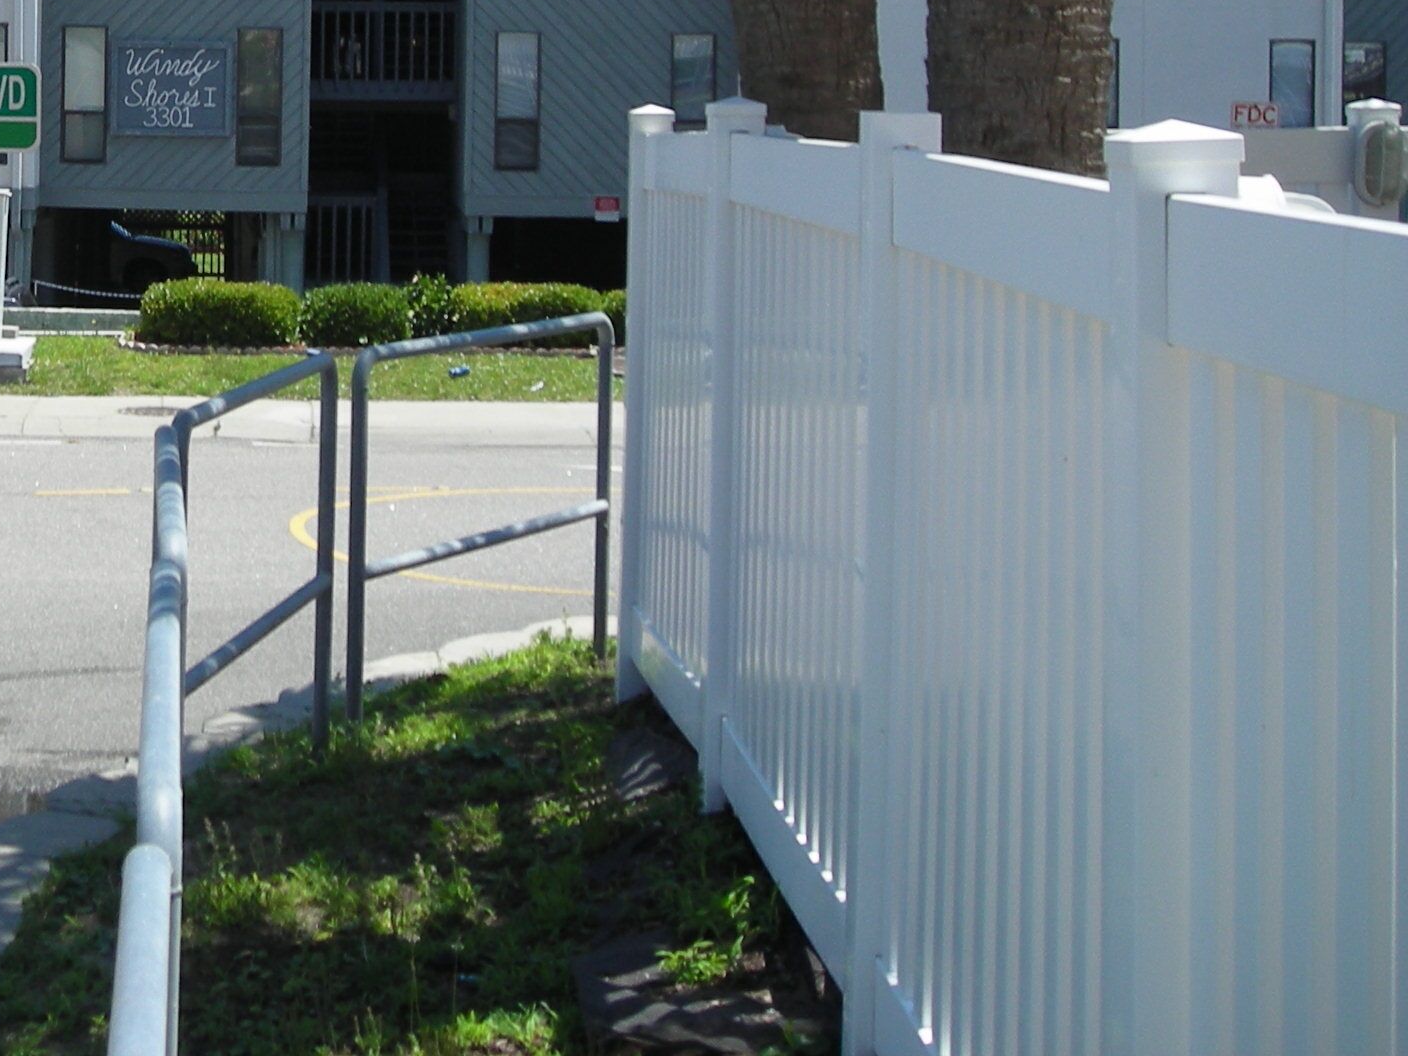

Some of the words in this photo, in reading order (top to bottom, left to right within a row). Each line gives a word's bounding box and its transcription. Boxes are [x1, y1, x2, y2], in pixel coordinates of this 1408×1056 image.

[126, 48, 220, 87] Windy
[124, 78, 201, 108] Shores
[203, 86, 218, 108] I
[143, 107, 194, 128] 3301
[1234, 104, 1276, 125] FDC
